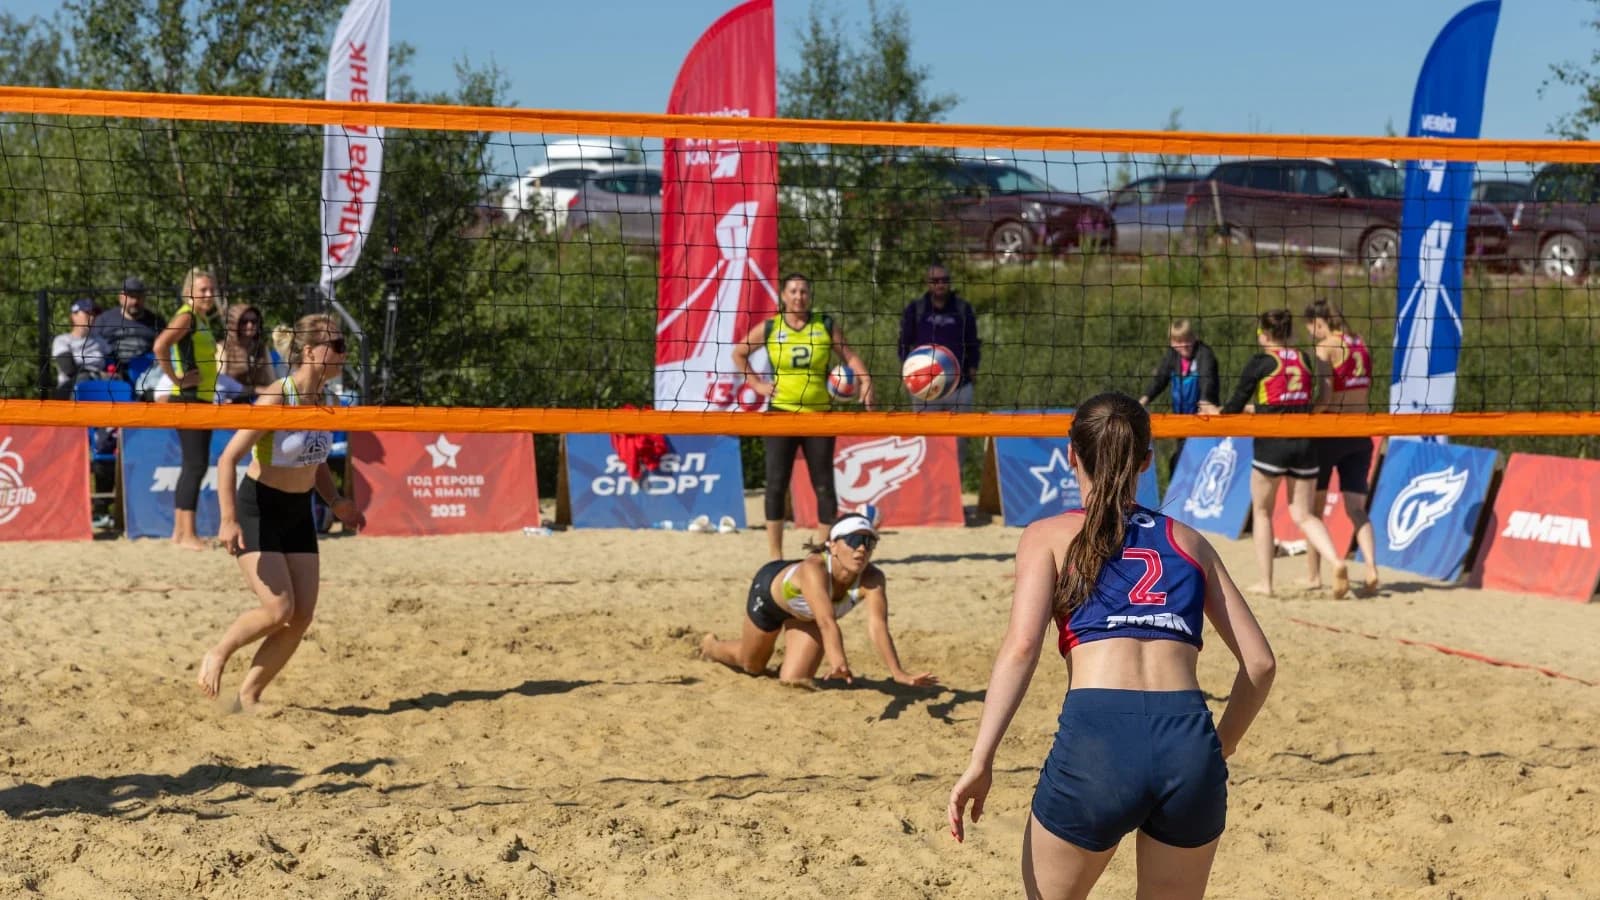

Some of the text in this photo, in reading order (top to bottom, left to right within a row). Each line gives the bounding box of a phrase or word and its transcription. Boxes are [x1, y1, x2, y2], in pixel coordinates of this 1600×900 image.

[792, 346, 810, 368] 2
[1285, 366, 1303, 391] 2
[407, 474, 485, 487] ГОД ГЕРОЕВ
[592, 474, 721, 495] СПОРТ
[412, 486, 481, 498] НА ЯМАЛЕ
[1501, 510, 1592, 549] ЯМАЛ
[1121, 547, 1167, 606] 2
